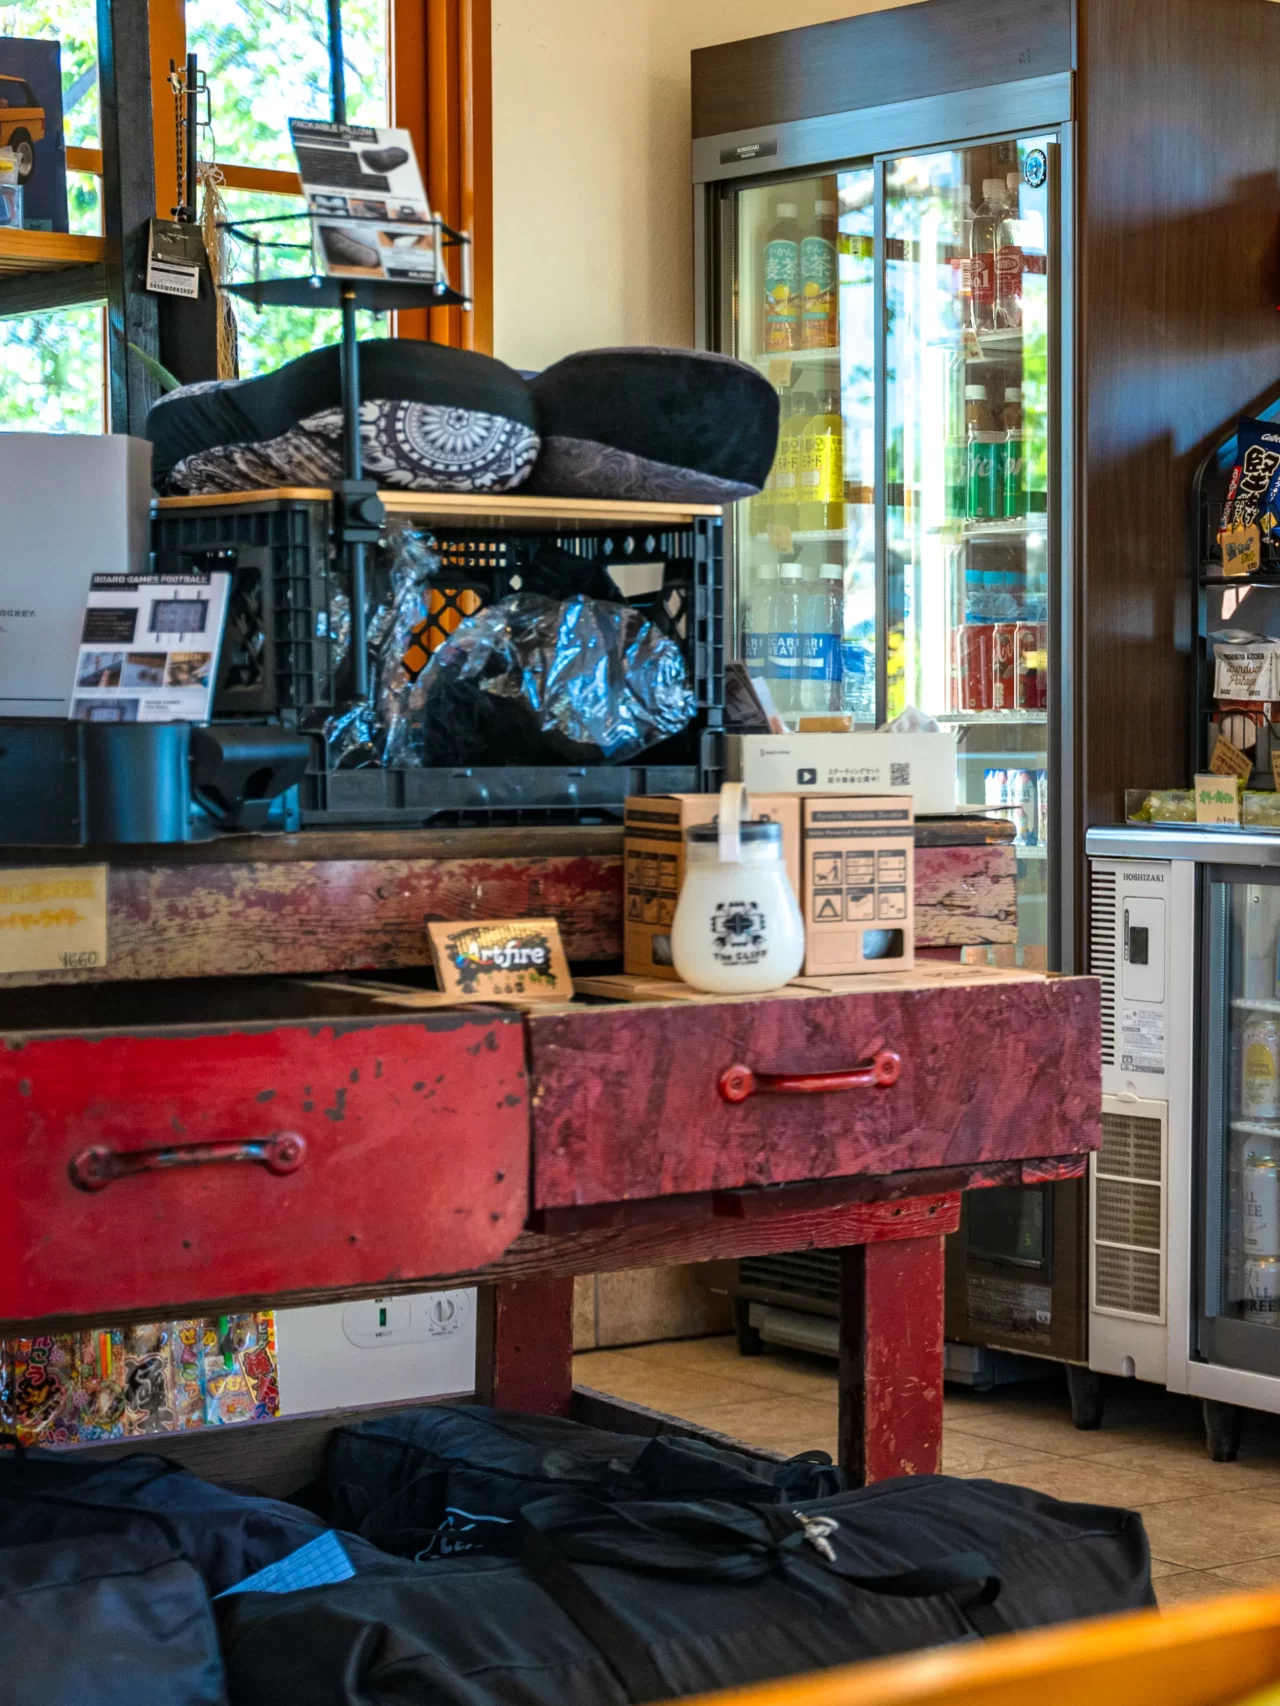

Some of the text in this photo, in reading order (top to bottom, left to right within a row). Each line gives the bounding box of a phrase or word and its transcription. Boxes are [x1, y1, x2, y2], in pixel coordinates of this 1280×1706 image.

[764, 257, 800, 280] 麦茶
[93, 575, 208, 584] BOARD GAMES FOOTBALL
[1123, 873, 1165, 883] HOSHIZAKI
[468, 940, 545, 968] Artfire
[1245, 1283, 1272, 1299] ALL
